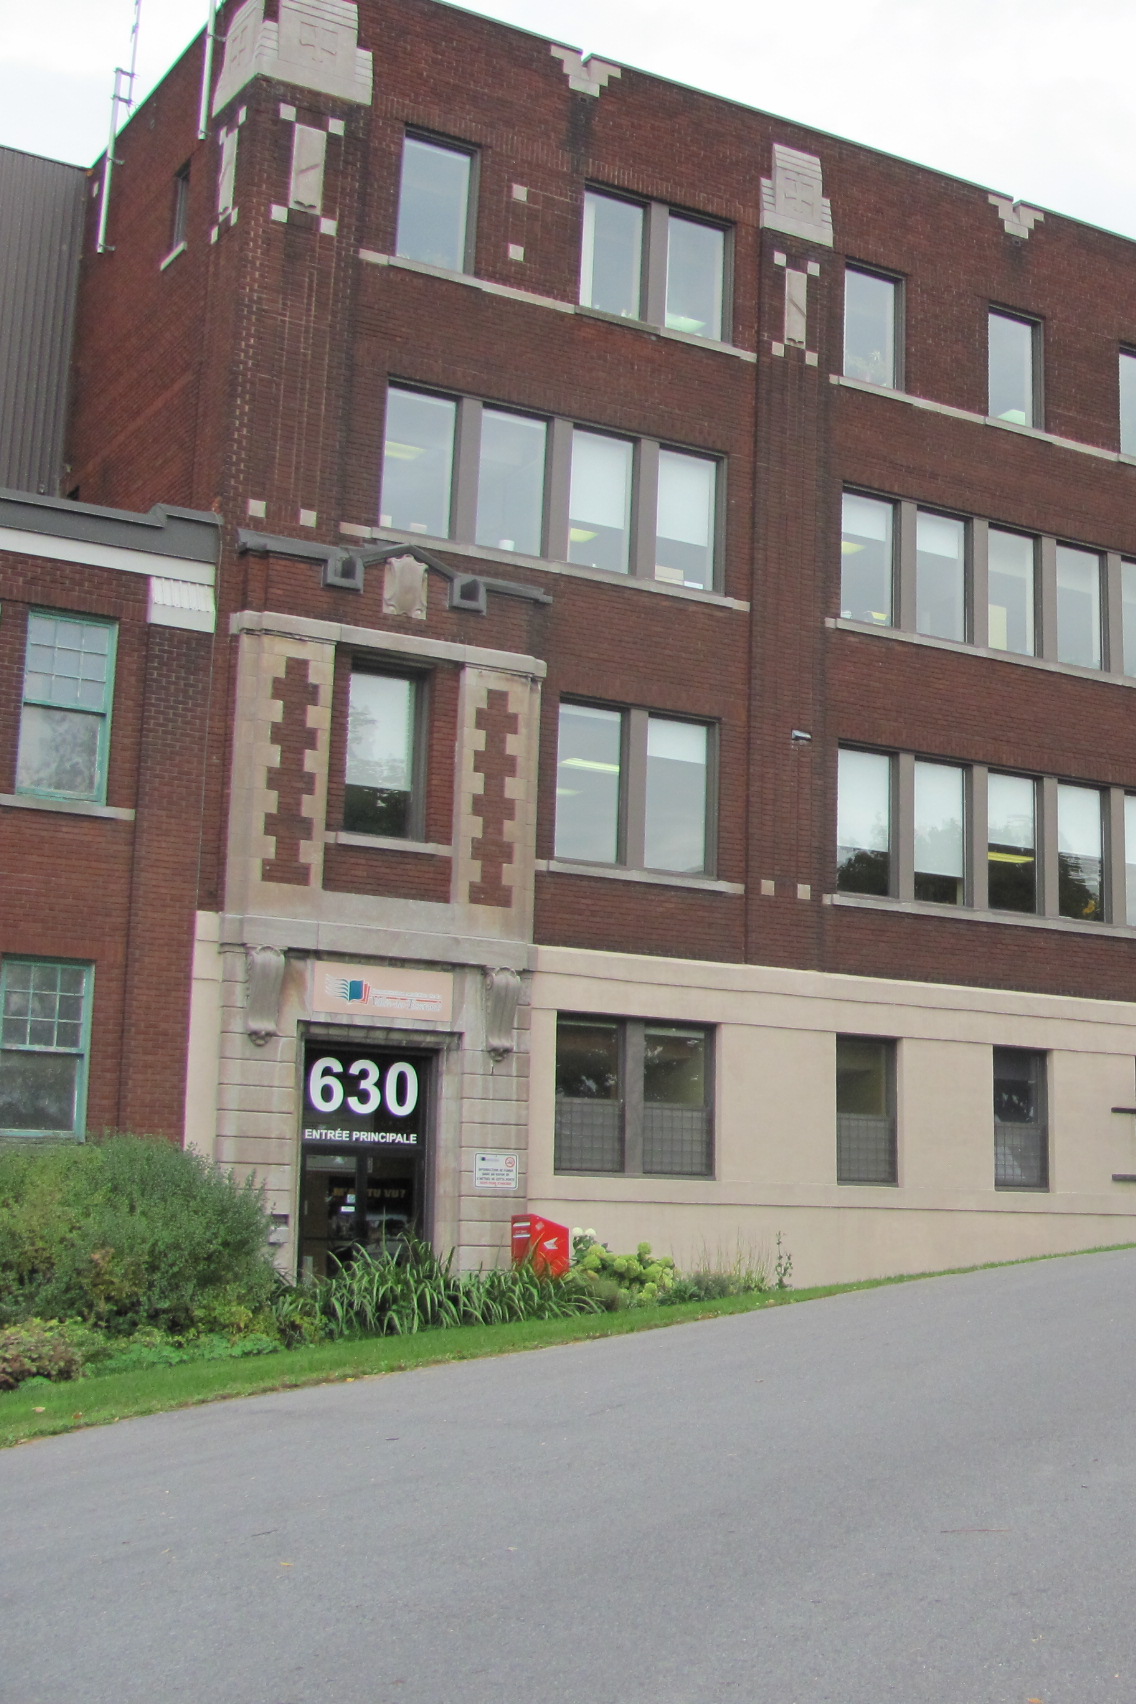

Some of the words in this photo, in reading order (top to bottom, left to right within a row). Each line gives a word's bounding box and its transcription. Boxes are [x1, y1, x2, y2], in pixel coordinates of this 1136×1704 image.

[309, 1056, 418, 1116] 630
[304, 1128, 350, 1141] ENTRÉE
[352, 1131, 417, 1144] PRINCIPALE
